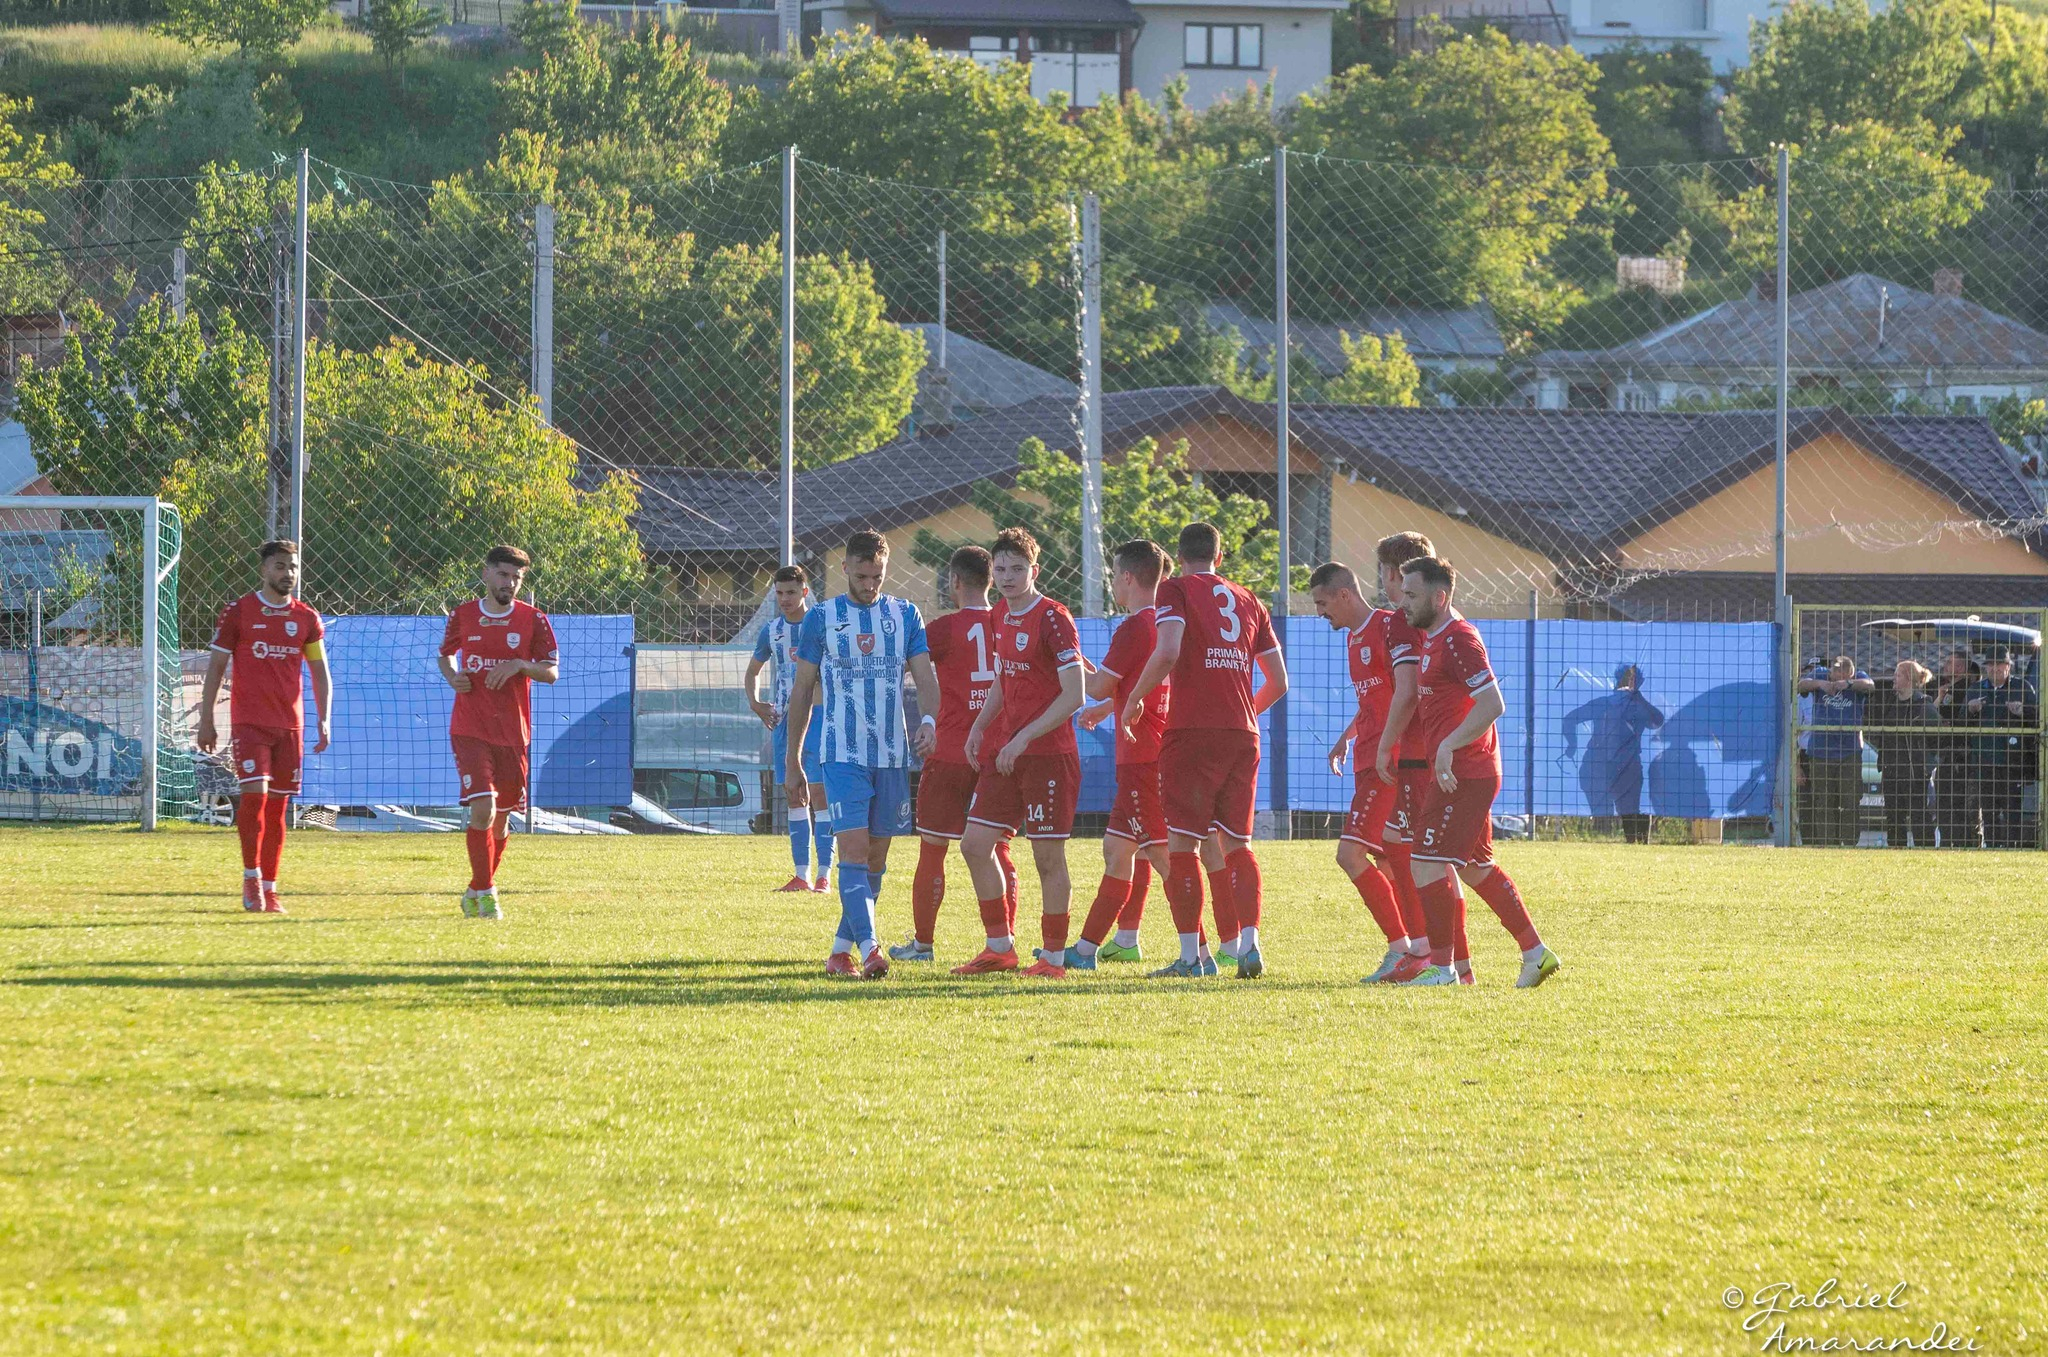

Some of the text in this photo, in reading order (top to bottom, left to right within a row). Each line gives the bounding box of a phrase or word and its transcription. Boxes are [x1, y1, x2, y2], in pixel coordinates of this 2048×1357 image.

[1213, 584, 1241, 642] 3
[967, 622, 995, 681] 1
[7, 728, 112, 779] NOI
[830, 801, 843, 820] 11
[1027, 803, 1045, 822] 14
[1423, 827, 1436, 846] 5
